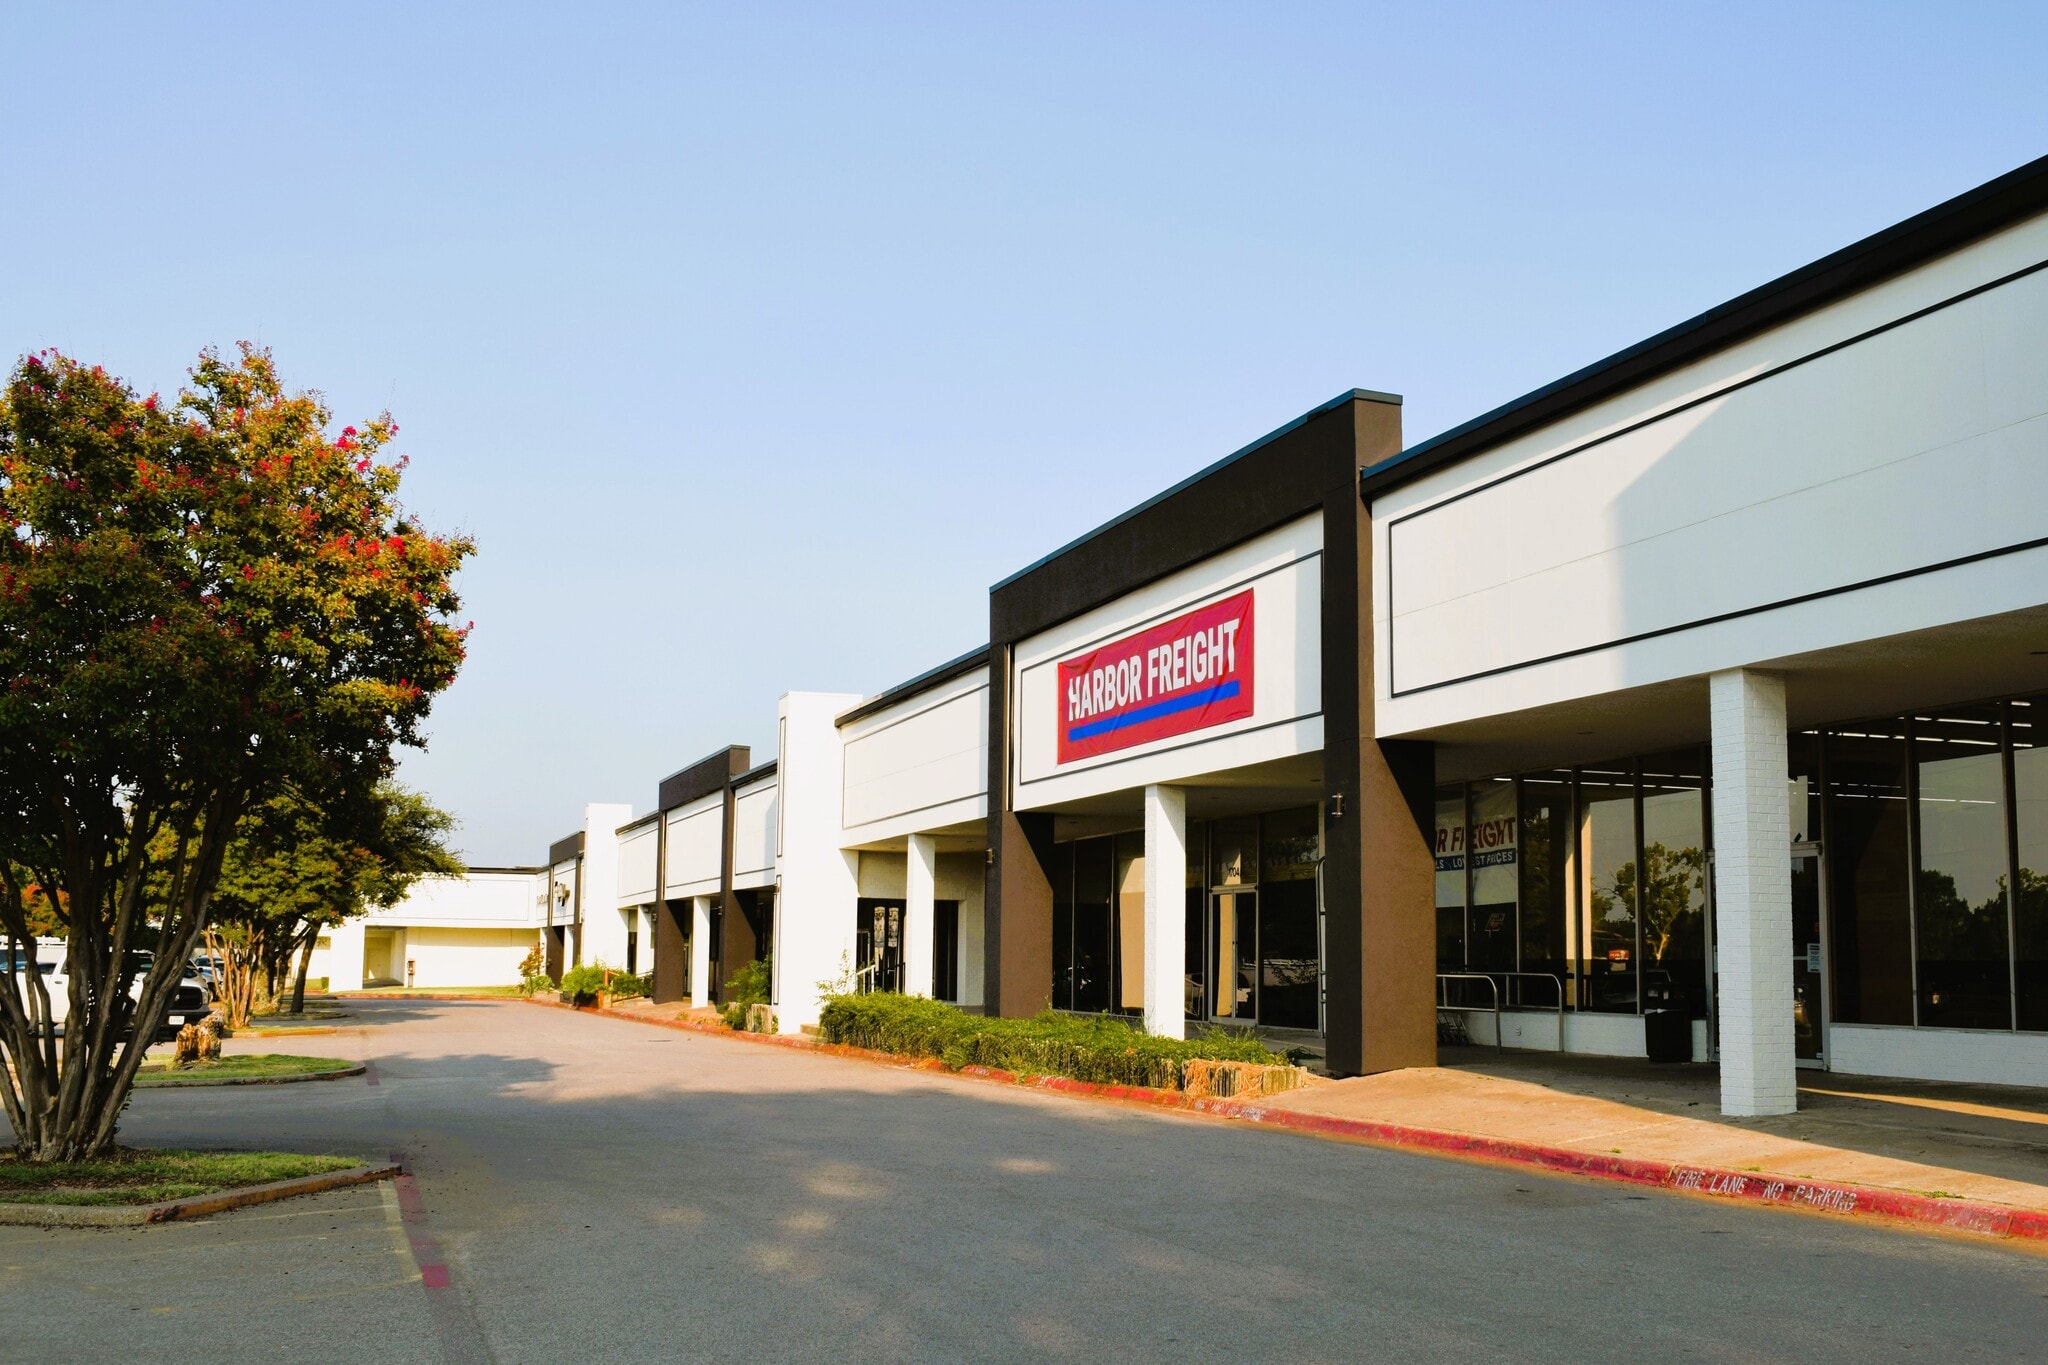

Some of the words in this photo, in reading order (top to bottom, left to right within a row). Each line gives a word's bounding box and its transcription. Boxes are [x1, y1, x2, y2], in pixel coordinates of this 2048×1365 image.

[1068, 655, 1142, 721] HARBOR
[1147, 618, 1240, 697] FREIGHT
[1675, 1169, 1706, 1191] FIRE
[1709, 1173, 1748, 1194] LANE
[1762, 1181, 1785, 1201] NO
[1793, 1184, 1858, 1211] PARKING
